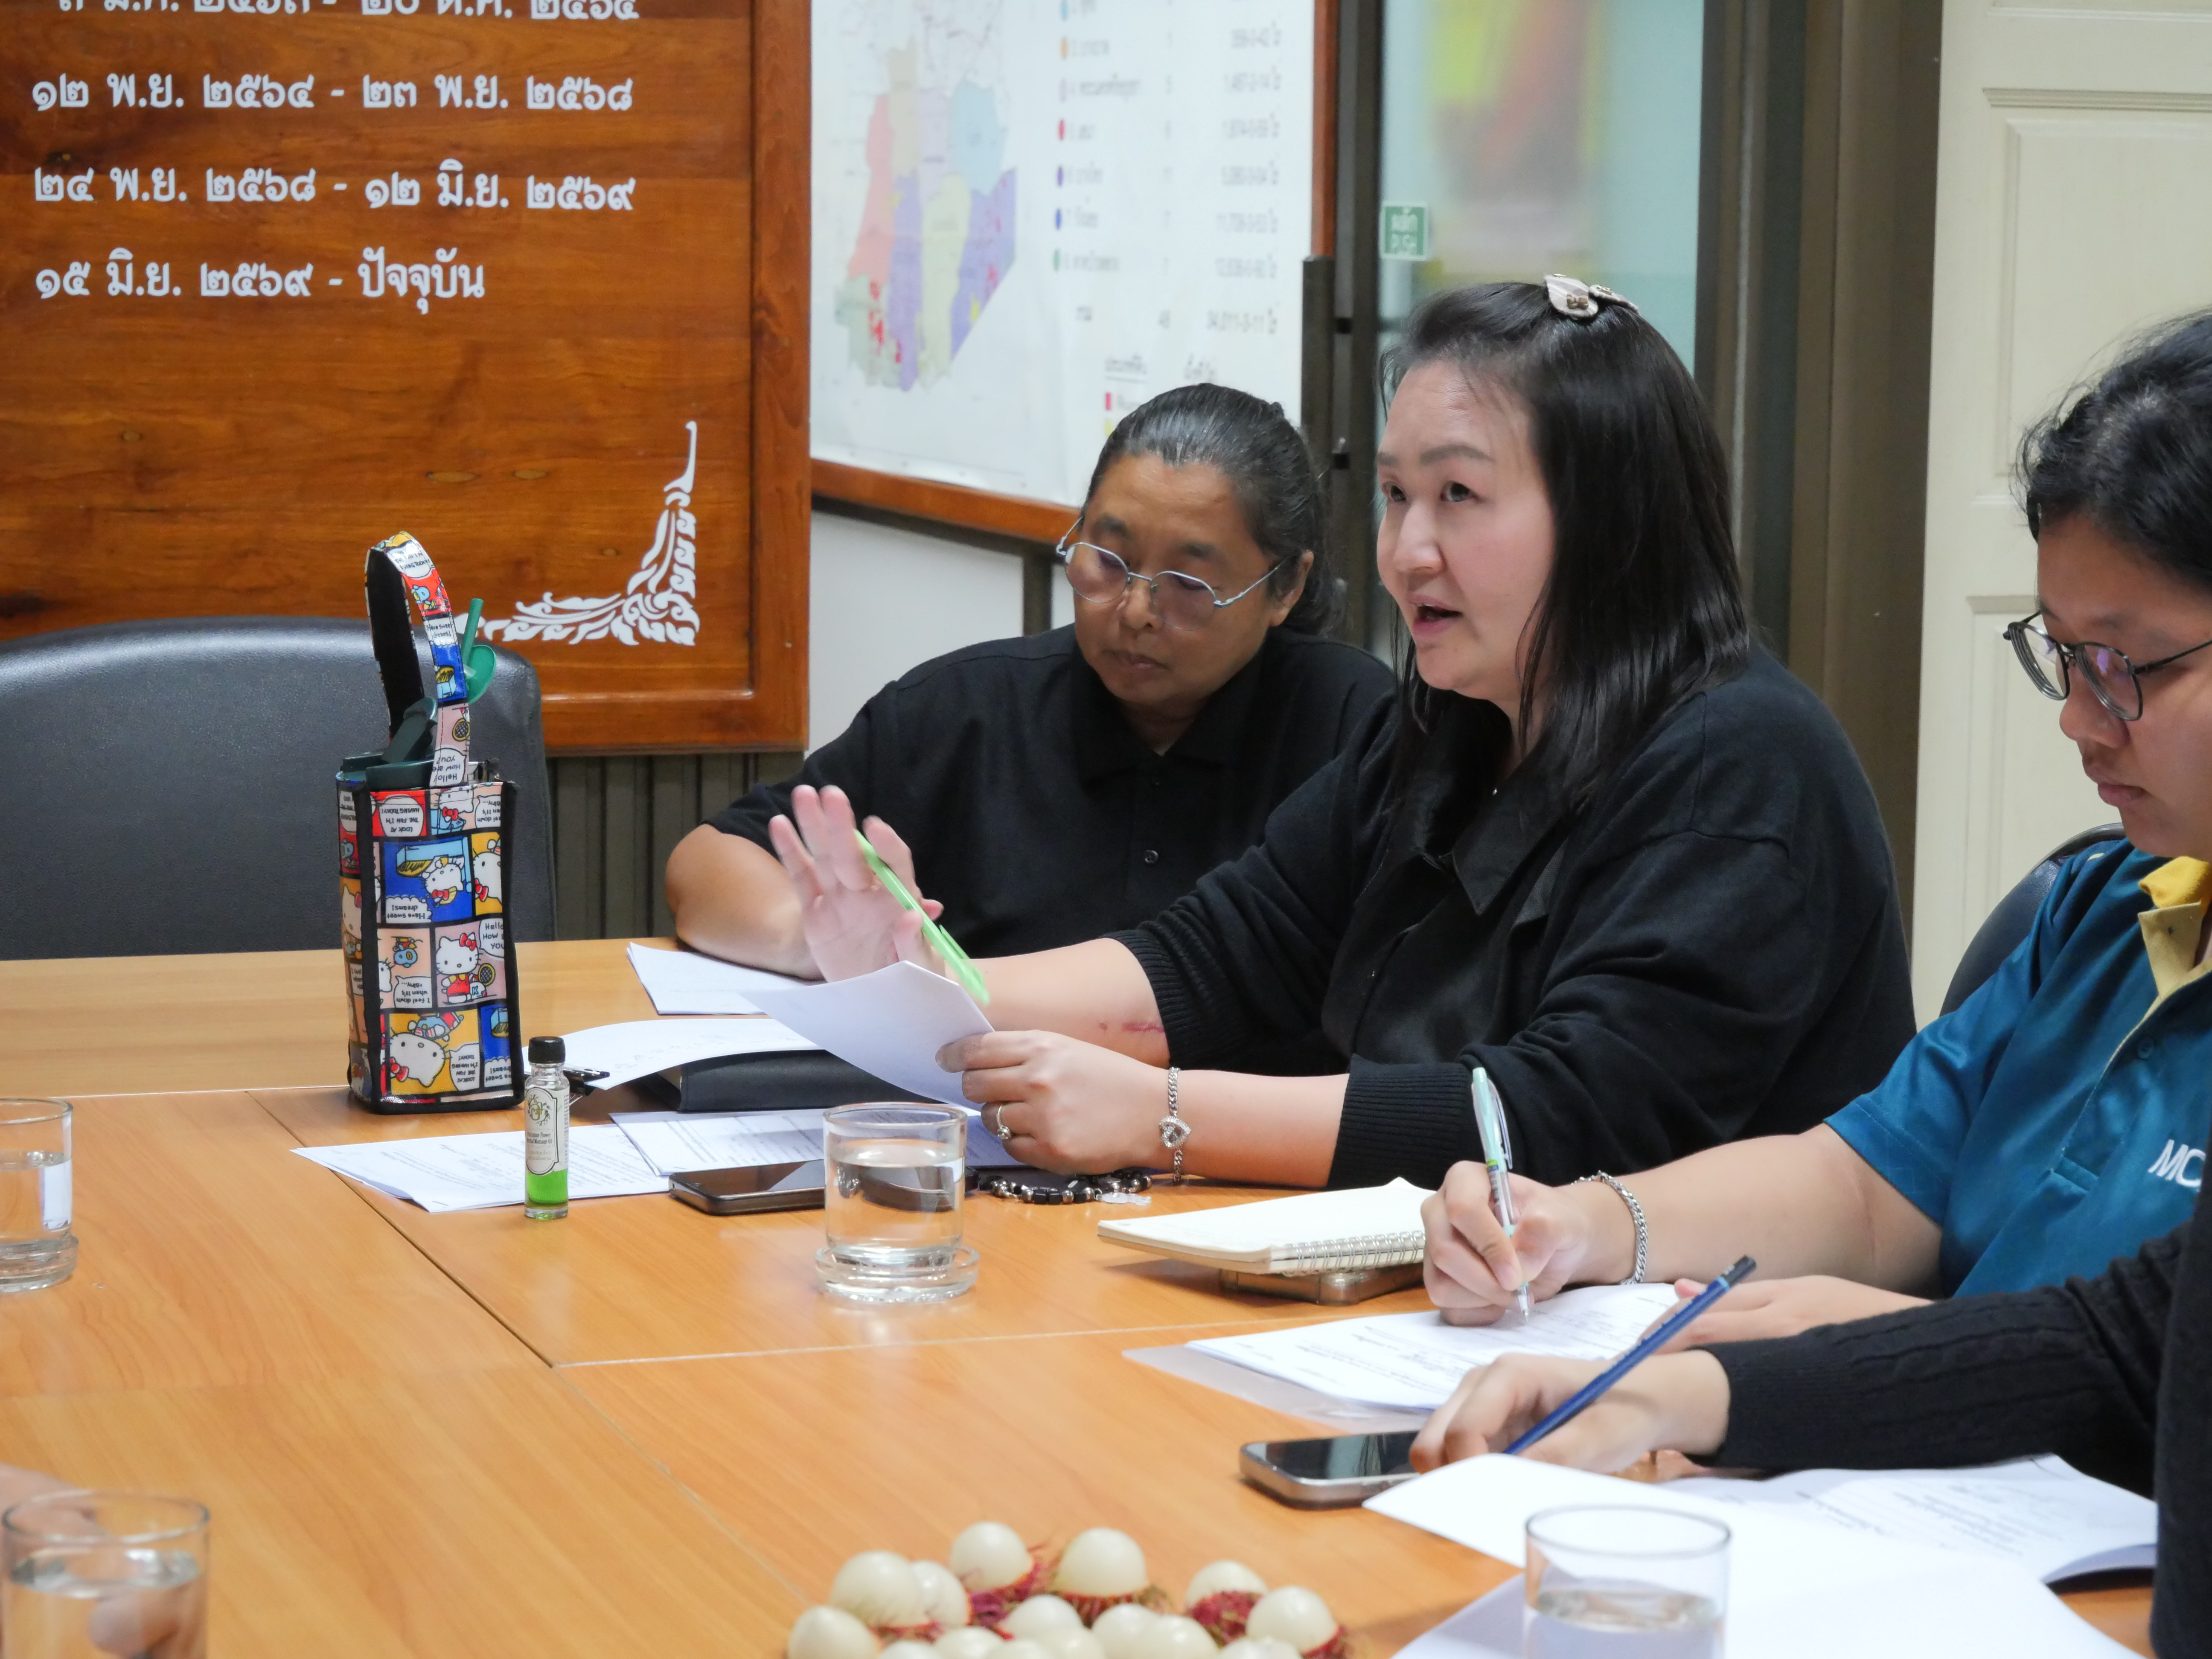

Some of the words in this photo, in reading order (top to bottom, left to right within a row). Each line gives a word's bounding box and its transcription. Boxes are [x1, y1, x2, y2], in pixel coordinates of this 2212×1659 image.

[32, 73, 89, 111] ๑๒
[106, 73, 184, 108] พ.ย.
[203, 74, 315, 108] ๒๕๖๔
[362, 74, 417, 108] ๒๓
[434, 74, 509, 109] พ.ย.
[526, 76, 633, 111] ๒๕๖๘
[35, 167, 94, 201] ๒๔
[109, 167, 187, 202] พ.ย.
[206, 168, 316, 202] ๒๕๖๘
[365, 171, 421, 209] ๑๒
[437, 157, 509, 208] มิ.ย.
[526, 175, 636, 211] ๒๕๖๙
[35, 261, 91, 299] ๑๕
[106, 247, 181, 297] มิ.ย.
[200, 262, 314, 297] ๒๕๖๙
[357, 246, 485, 315] ปัจจุบัน
